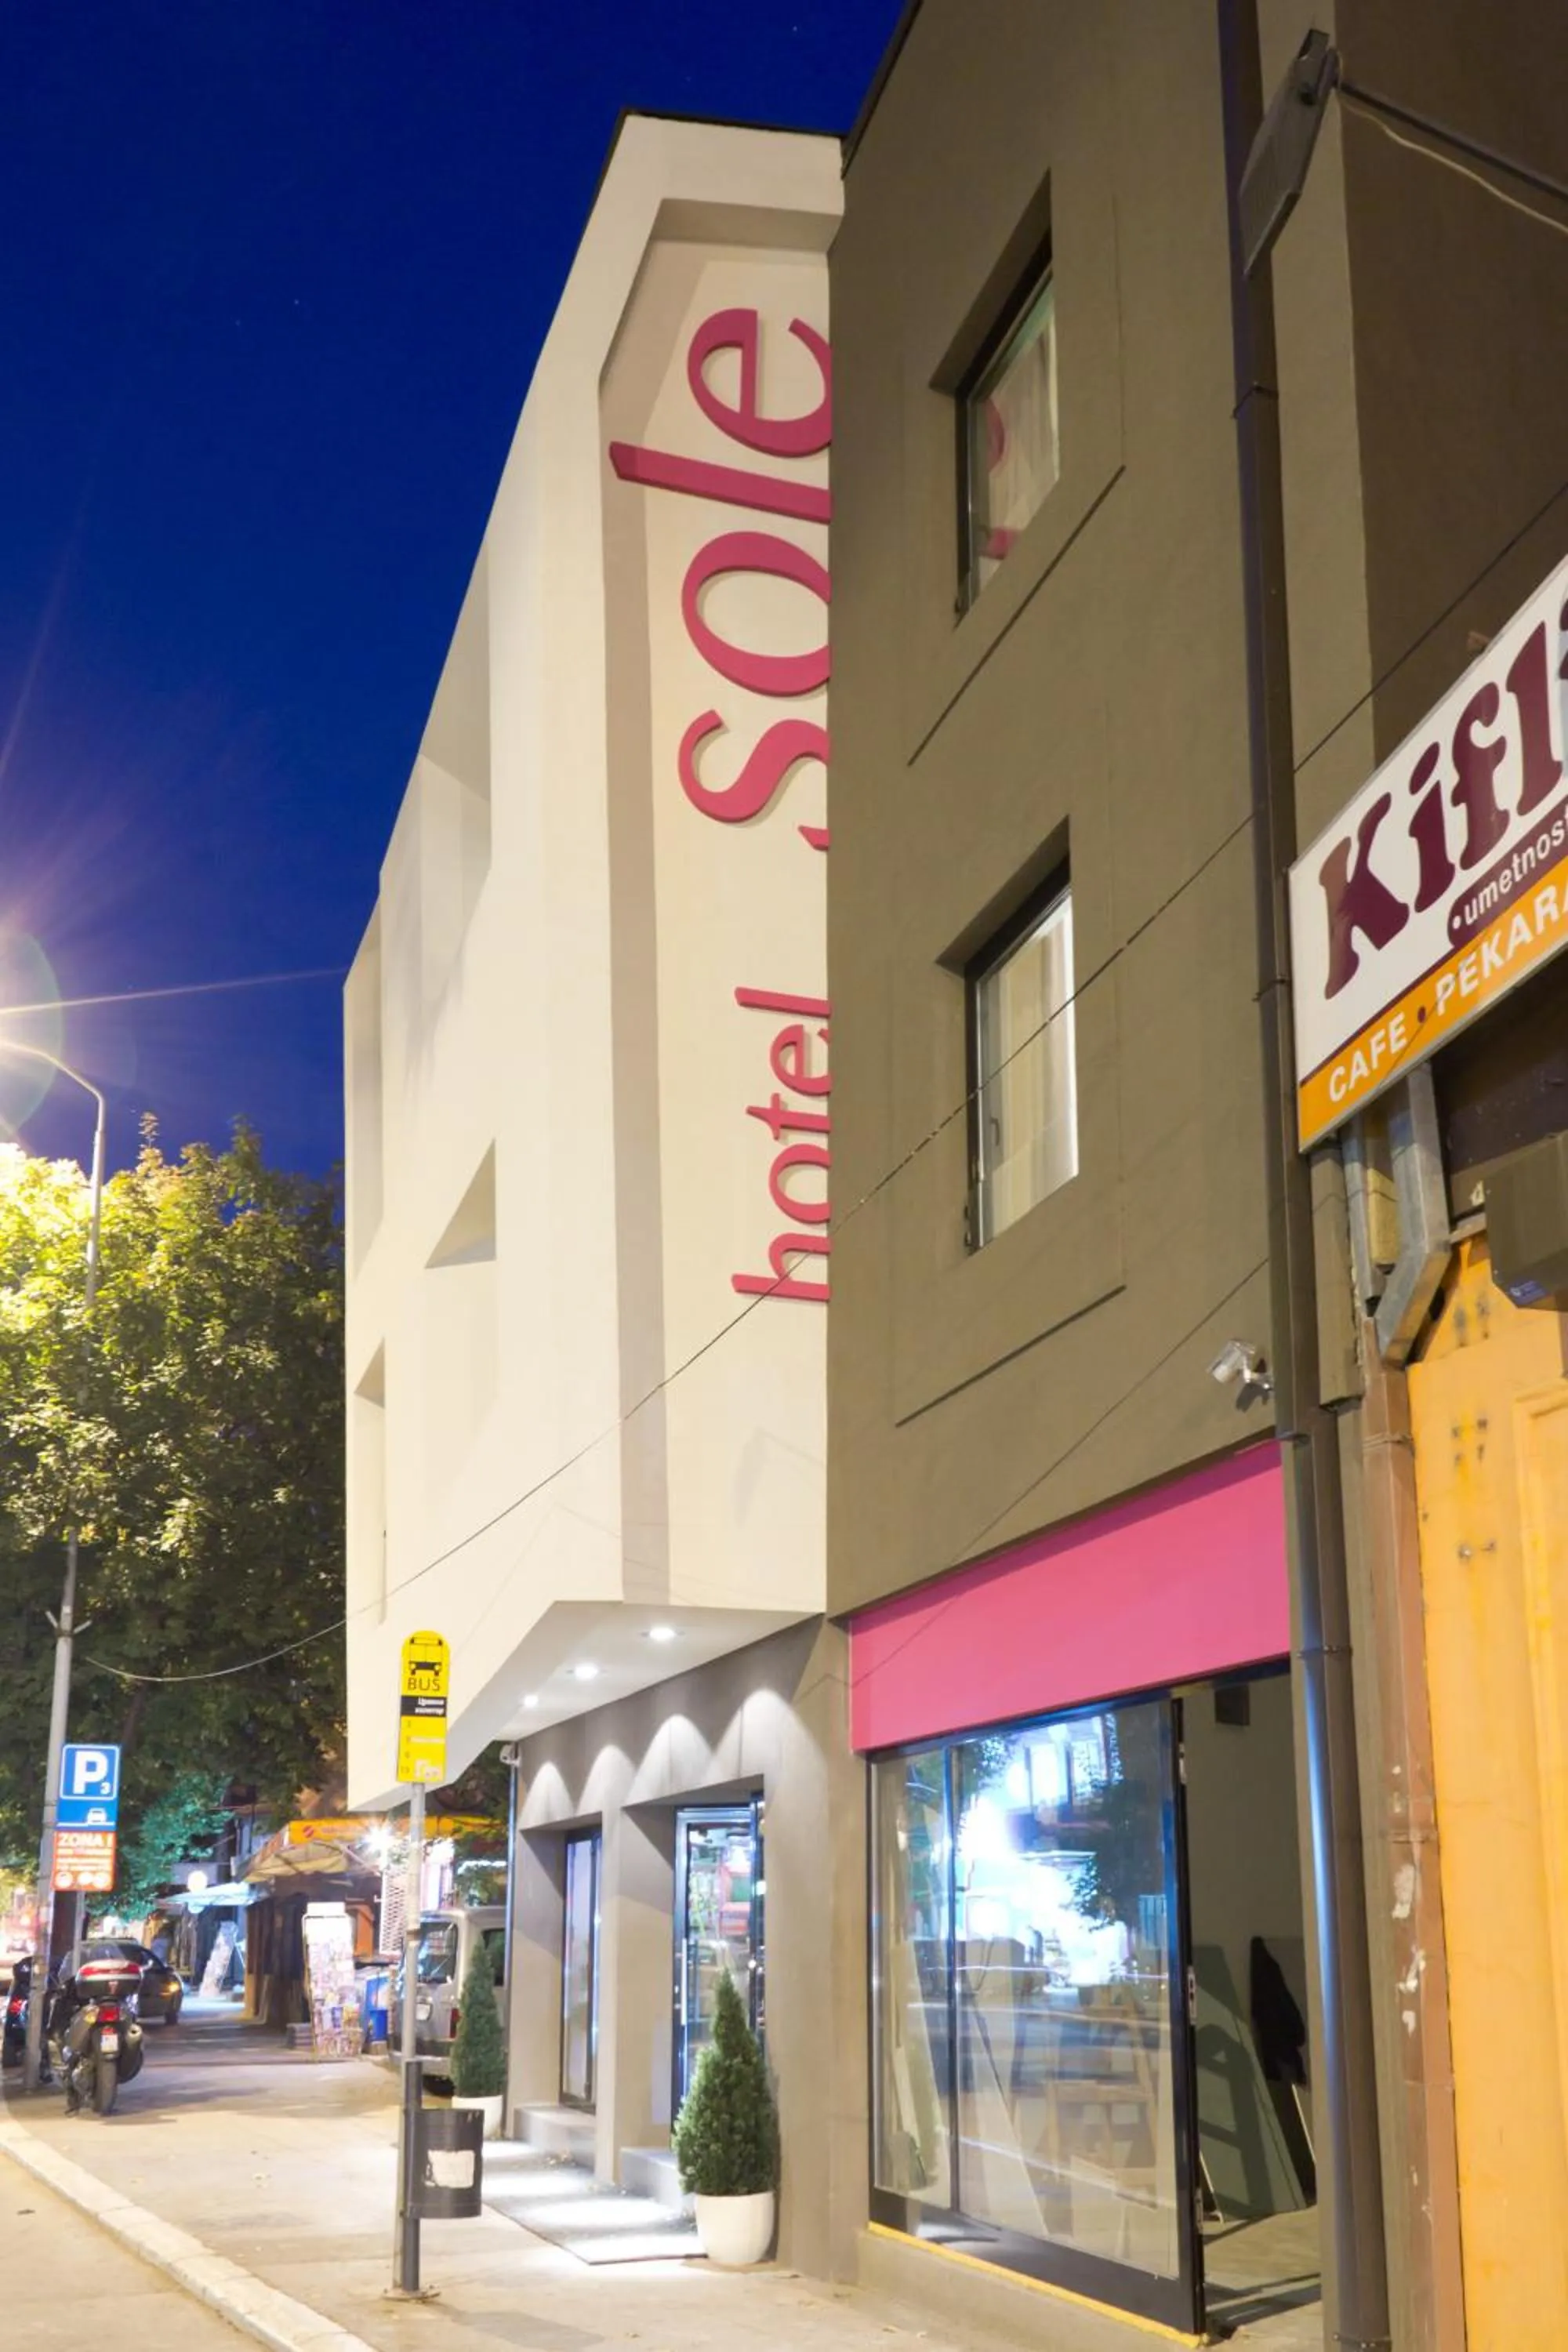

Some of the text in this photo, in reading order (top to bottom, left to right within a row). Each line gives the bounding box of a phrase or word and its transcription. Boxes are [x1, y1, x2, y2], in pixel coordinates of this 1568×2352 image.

[1319, 592, 1568, 1000] Kifl
[1329, 881, 1568, 1102] CAFE PEKAR
[731, 986, 832, 1302] hotel
[407, 1677, 441, 1691] BUS
[58, 1832, 103, 1846] ZONA
